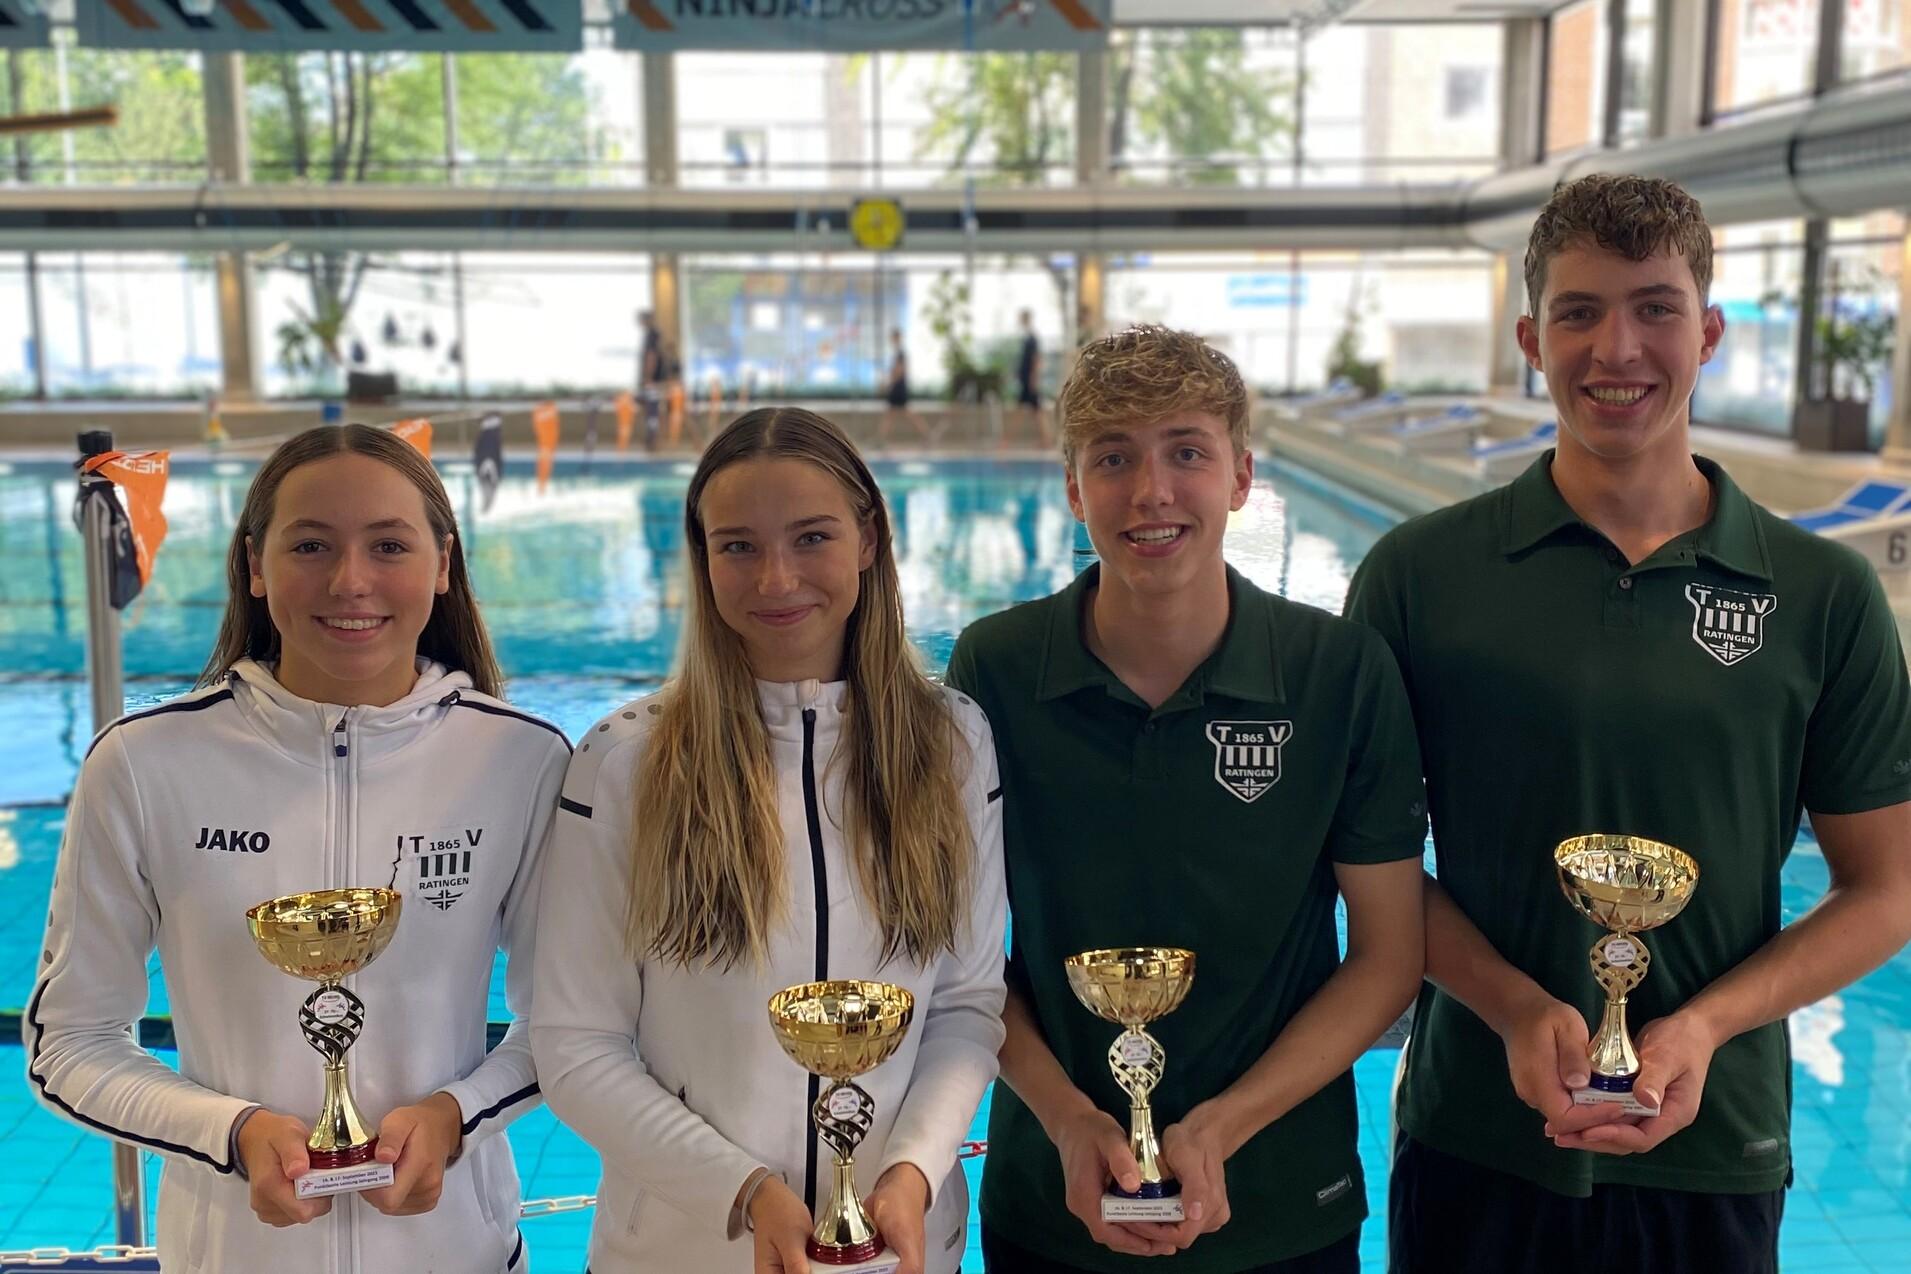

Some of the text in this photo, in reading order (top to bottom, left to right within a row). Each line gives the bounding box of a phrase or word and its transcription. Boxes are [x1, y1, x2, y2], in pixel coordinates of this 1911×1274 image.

[1888, 530, 1907, 565] 6
[1695, 588, 1770, 614] T 1865 V
[1703, 629, 1756, 645] RATINGEN
[1216, 725, 1286, 743] T 1865 V
[1224, 768, 1275, 777] RATINGEN
[195, 827, 271, 853] JAKO
[409, 828, 483, 854] T 1865 V
[418, 877, 470, 890] RATINGEN
